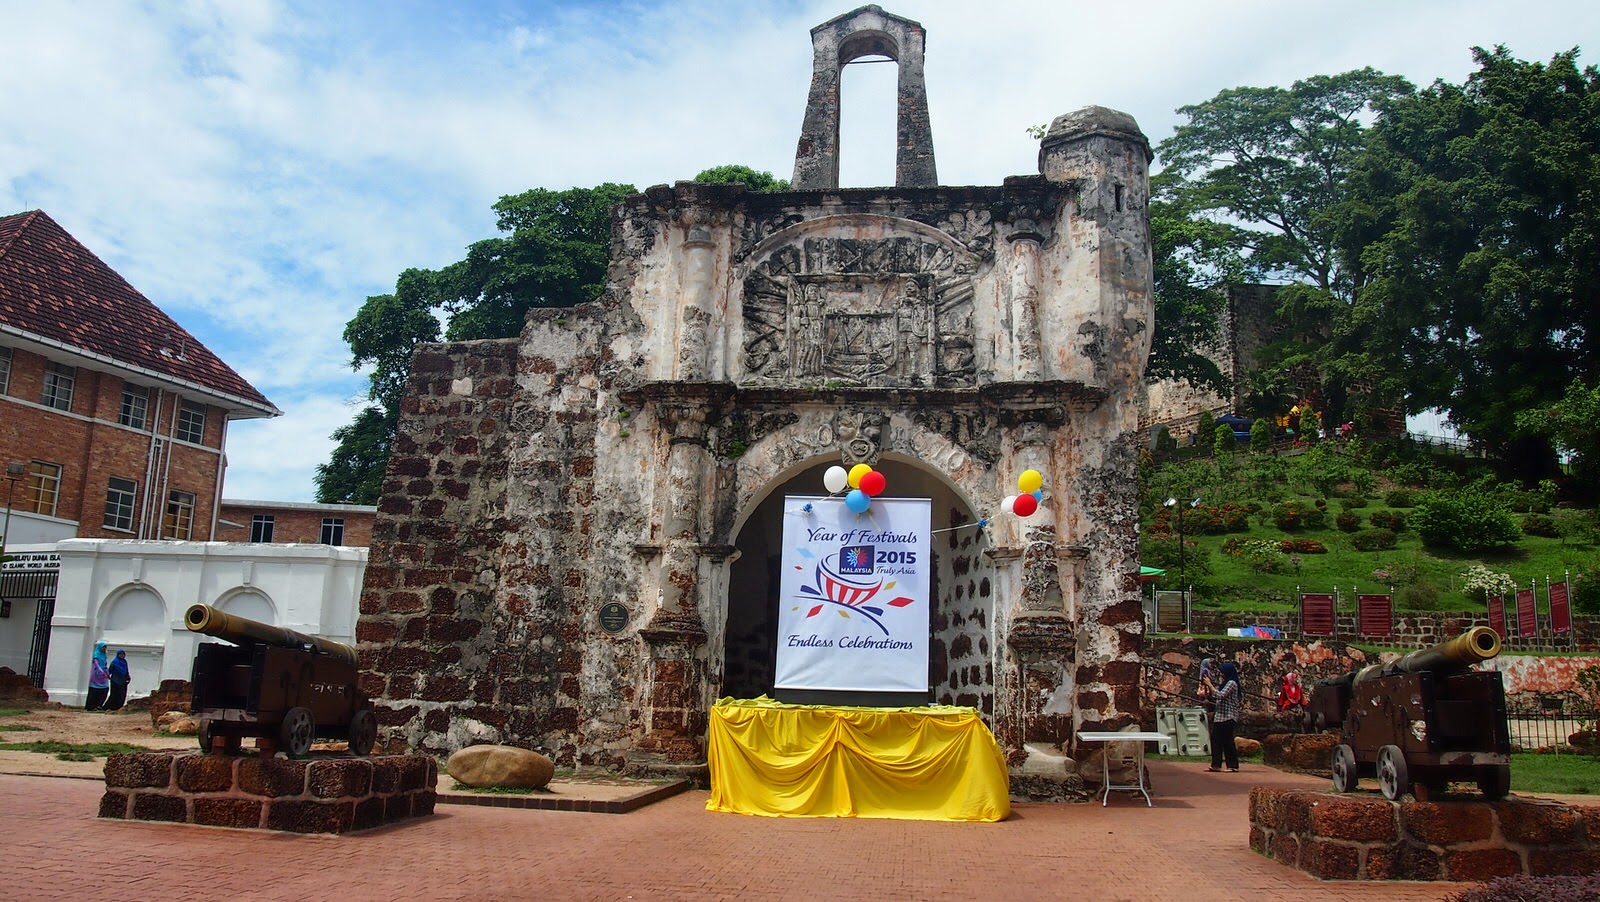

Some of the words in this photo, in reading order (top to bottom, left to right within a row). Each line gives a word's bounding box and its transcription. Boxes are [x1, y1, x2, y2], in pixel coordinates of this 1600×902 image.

[807, 527, 838, 542] Year
[840, 529, 857, 546] of
[858, 530, 917, 544] Festivals
[876, 551, 917, 564] 2015
[876, 566, 896, 575] Truly
[896, 567, 916, 575] Asia
[787, 634, 834, 647] Endless
[838, 635, 913, 650] Celebrations
